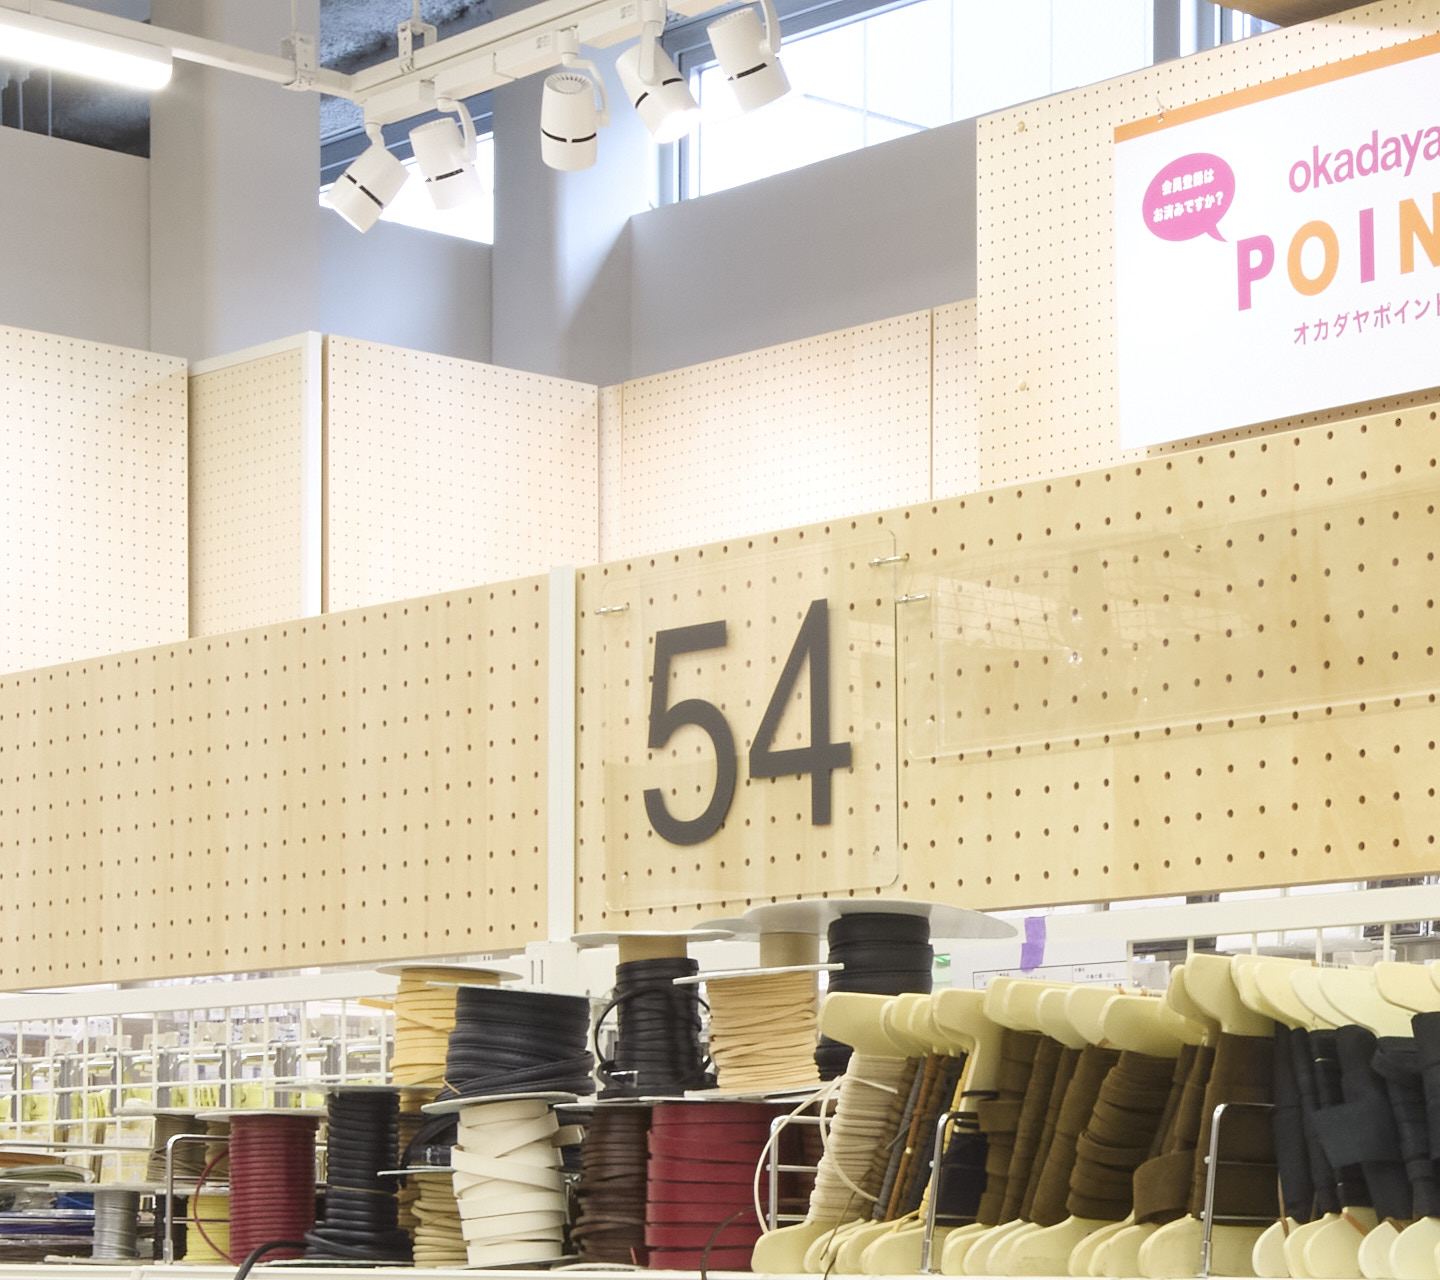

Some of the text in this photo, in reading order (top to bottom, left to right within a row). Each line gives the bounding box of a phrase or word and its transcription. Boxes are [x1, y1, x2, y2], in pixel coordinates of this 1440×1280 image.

[1161, 168, 1215, 196] 会員登録は
[644, 599, 856, 845] 54
